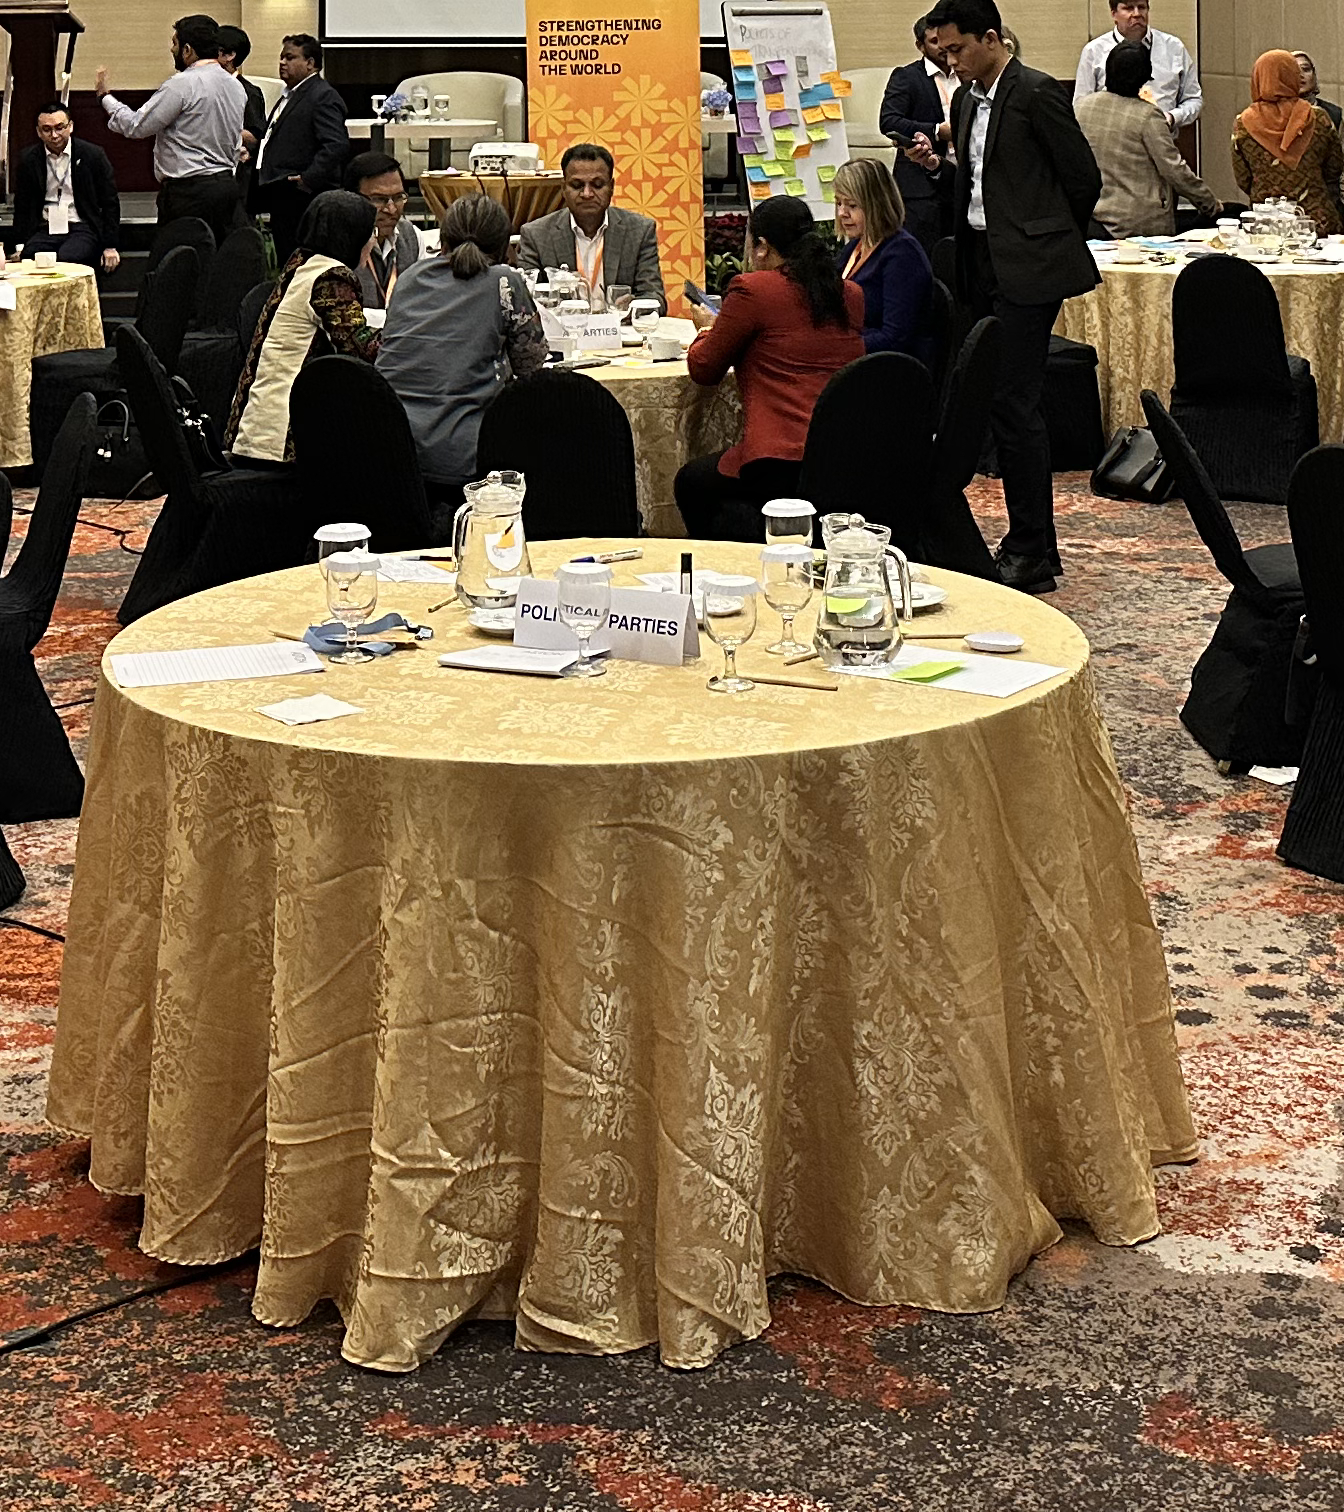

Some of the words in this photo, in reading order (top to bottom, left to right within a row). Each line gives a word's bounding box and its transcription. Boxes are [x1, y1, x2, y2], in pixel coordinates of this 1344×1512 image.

[538, 18, 662, 33] STRENGTHENING
[539, 33, 630, 47] DEMOCRACY
[538, 48, 600, 62] AROUND
[539, 63, 568, 76] THE
[569, 62, 622, 76] WORLD
[582, 327, 618, 337] ARTIES
[608, 613, 679, 637] PARTIES
